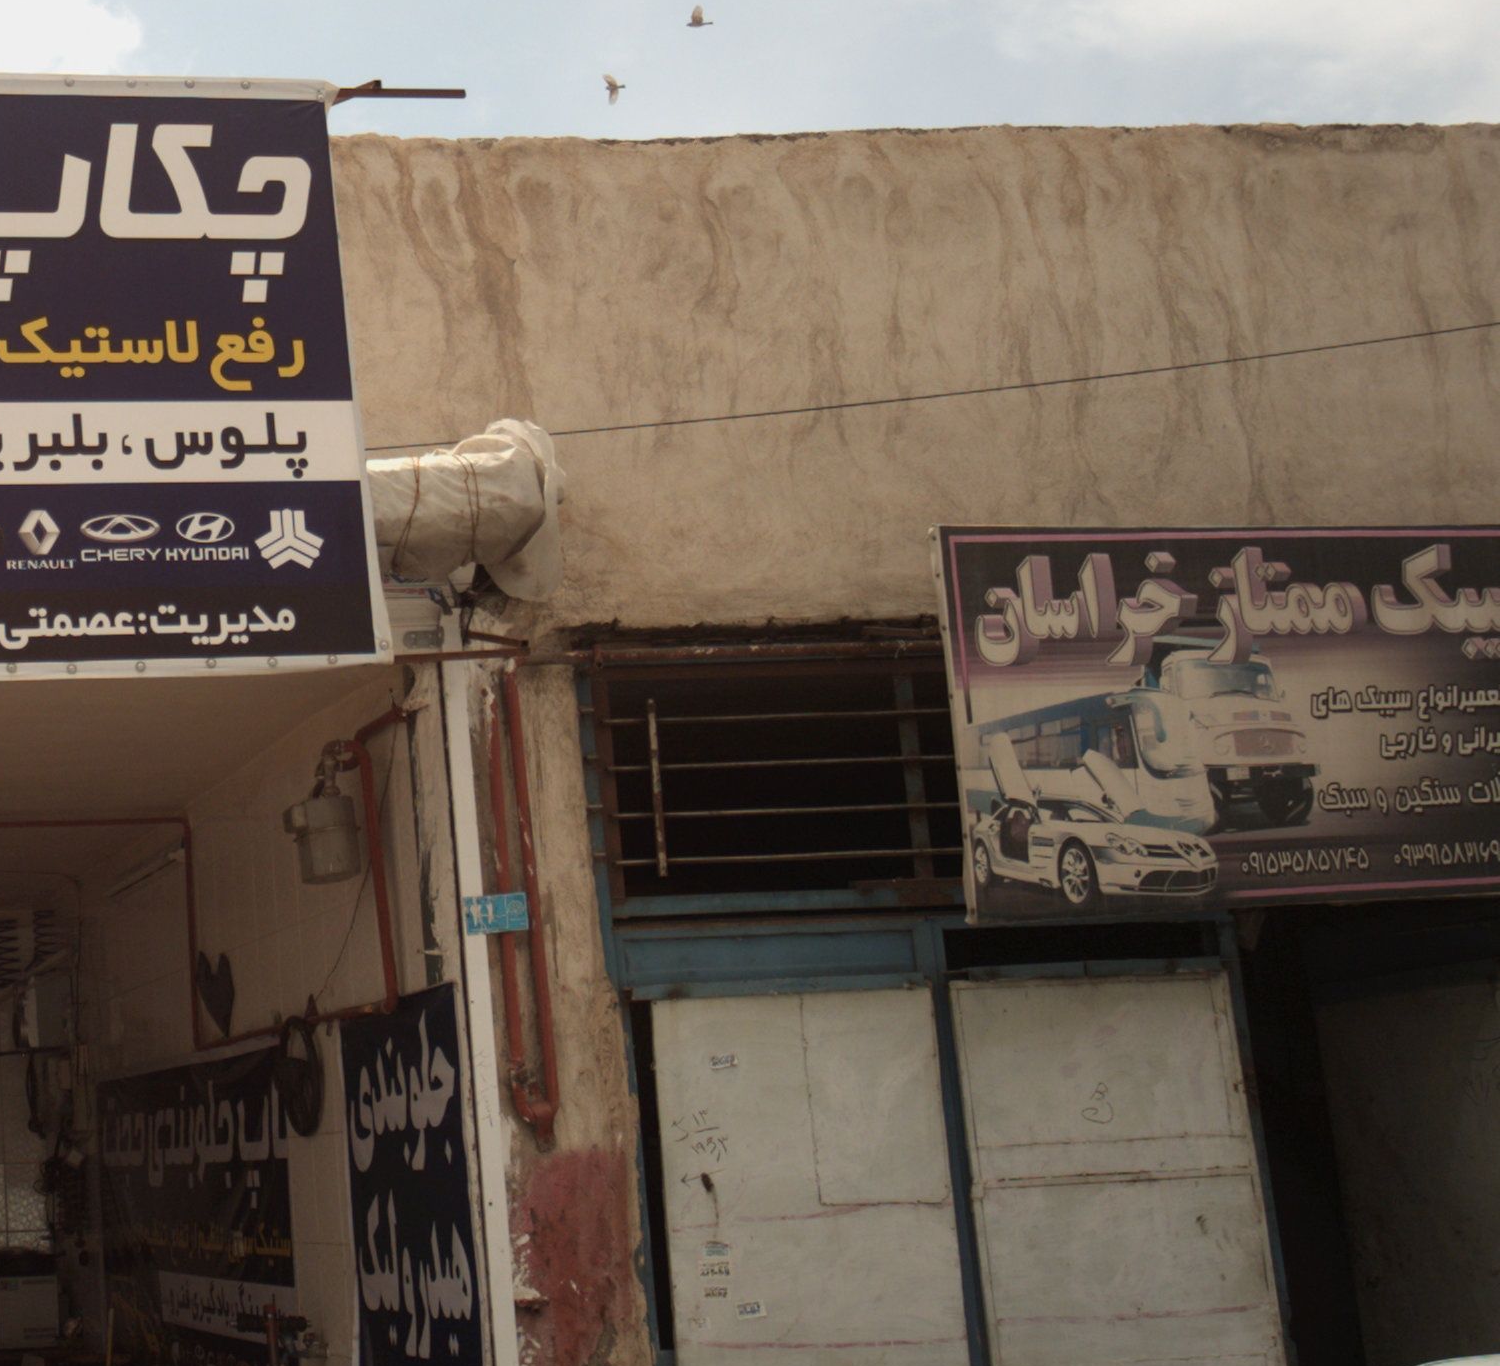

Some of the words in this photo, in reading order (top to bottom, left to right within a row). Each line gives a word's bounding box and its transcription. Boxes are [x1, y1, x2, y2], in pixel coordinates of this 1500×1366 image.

[208, 316, 305, 392] رفع
[6, 558, 76, 571] RENAULT
[80, 547, 162, 563] CHERY
[165, 546, 250, 561] HYUNDAI
[974, 551, 1199, 667] خراسان
[1208, 546, 1368, 665] ممتاز
[1311, 686, 1352, 719] های
[1458, 686, 1500, 715] عمیر
[1380, 725, 1438, 760] خارجی
[1441, 731, 1453, 755] و
[1318, 781, 1372, 816] سبک
[1375, 787, 1389, 815] و
[1395, 776, 1462, 814] سنگین
[350, 1008, 455, 1173] جلوبندی
[357, 1188, 474, 1361] هیدرولیک
